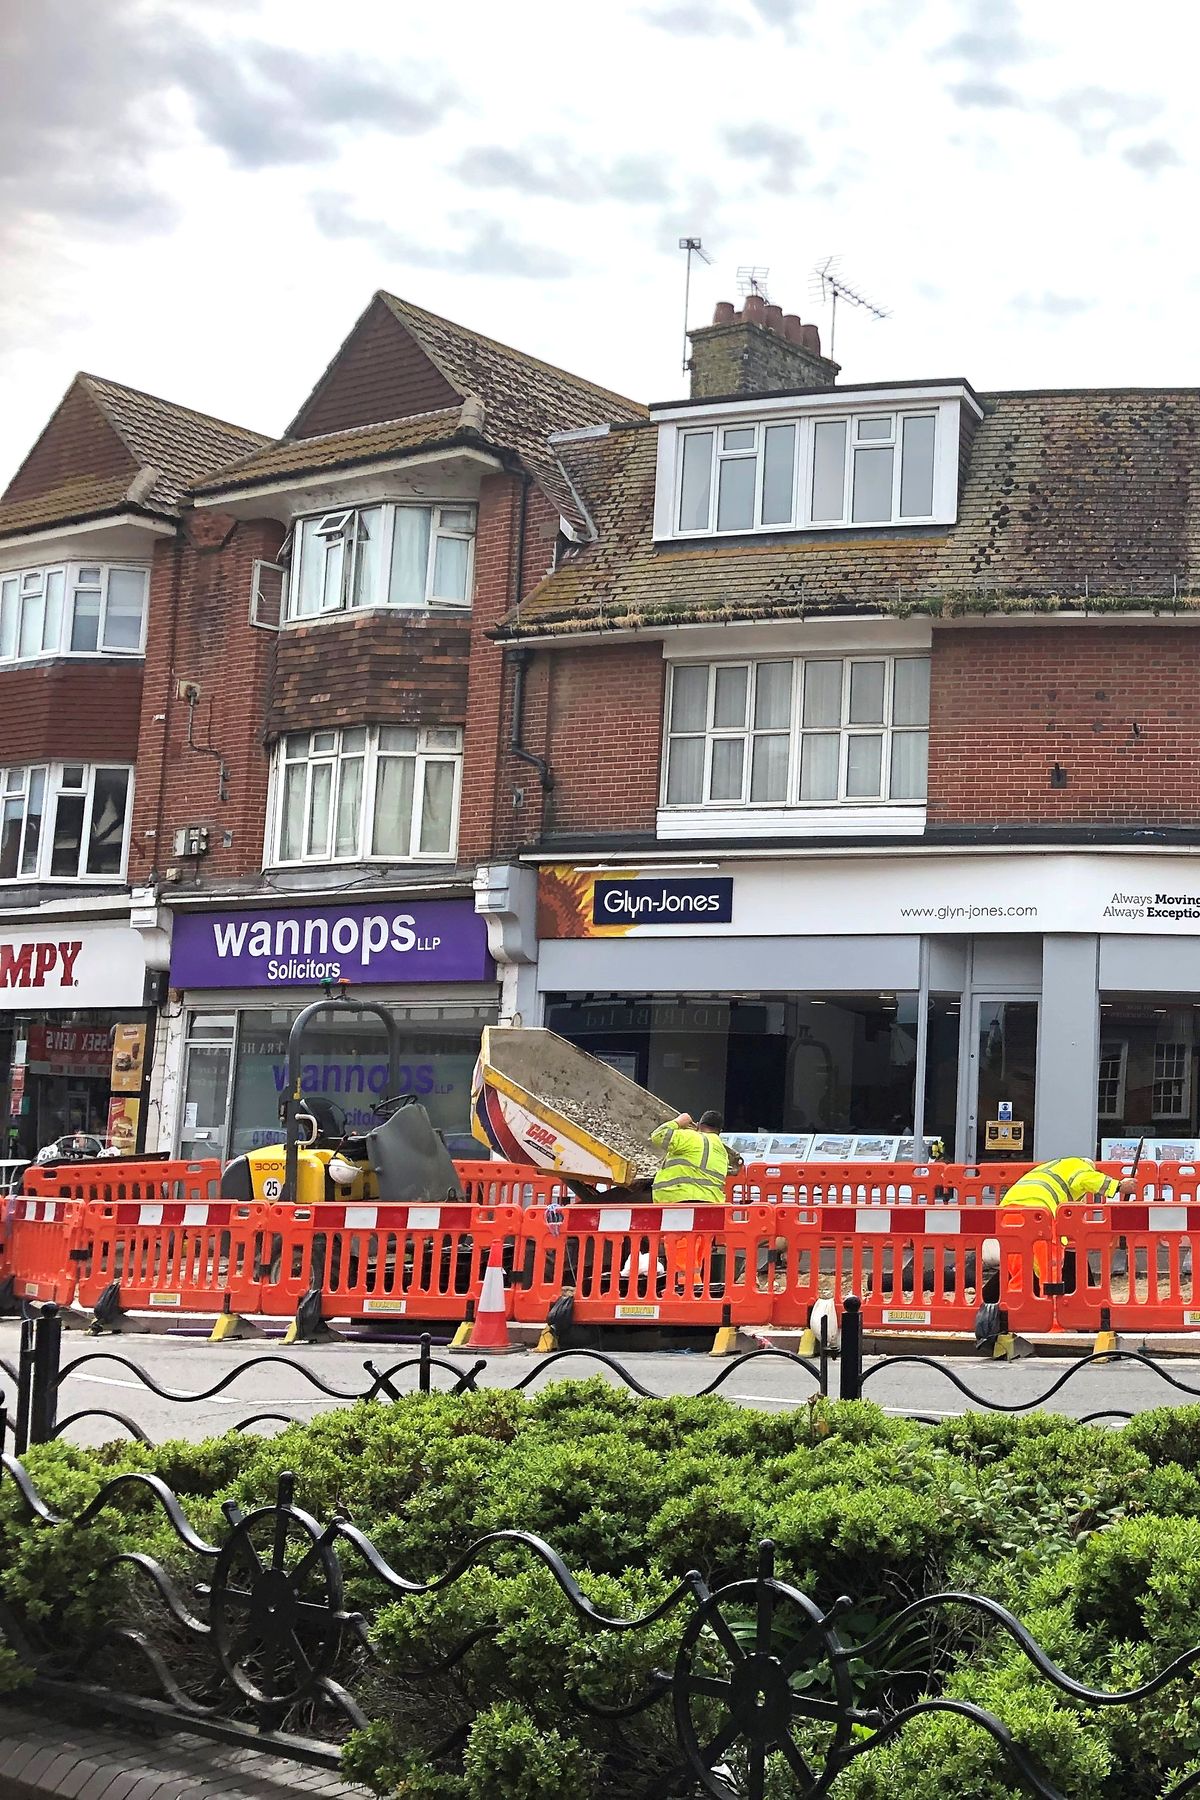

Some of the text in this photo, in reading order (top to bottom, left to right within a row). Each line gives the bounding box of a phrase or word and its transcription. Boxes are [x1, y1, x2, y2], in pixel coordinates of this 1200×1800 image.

[604, 890, 720, 918] Glyn-Jones
[1111, 893, 1153, 906] Always
[900, 904, 1038, 919] www.glyn-jones.com
[1103, 906, 1145, 919] Always
[214, 914, 441, 966] wannops LLP
[267, 959, 341, 980] Solicitors
[266, 1181, 278, 1196] 25
